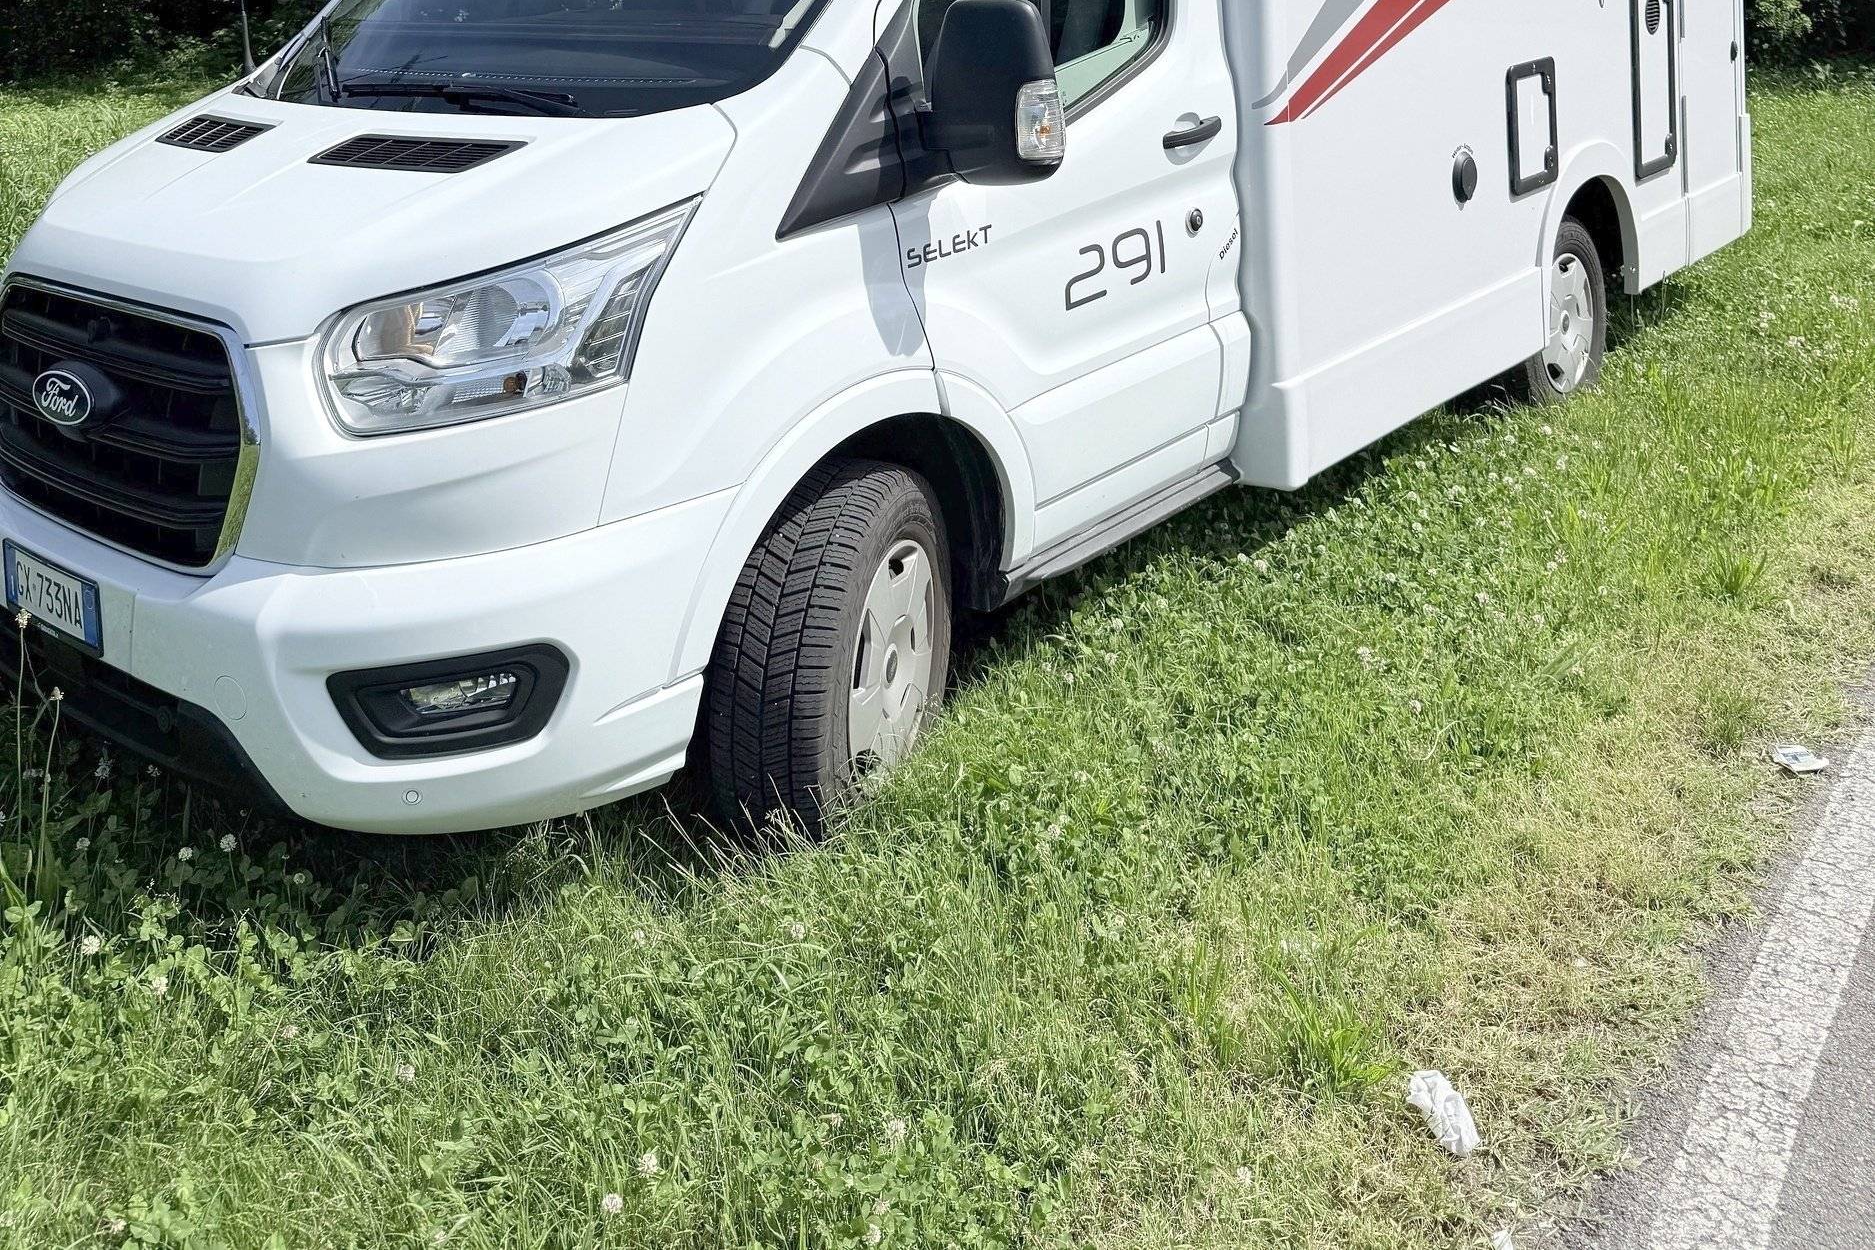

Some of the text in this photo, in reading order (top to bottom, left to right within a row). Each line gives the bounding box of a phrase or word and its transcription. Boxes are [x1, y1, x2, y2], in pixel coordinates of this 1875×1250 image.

[906, 224, 993, 269] SELEKT
[1065, 219, 1166, 311] 291
[41, 377, 79, 417] Ford
